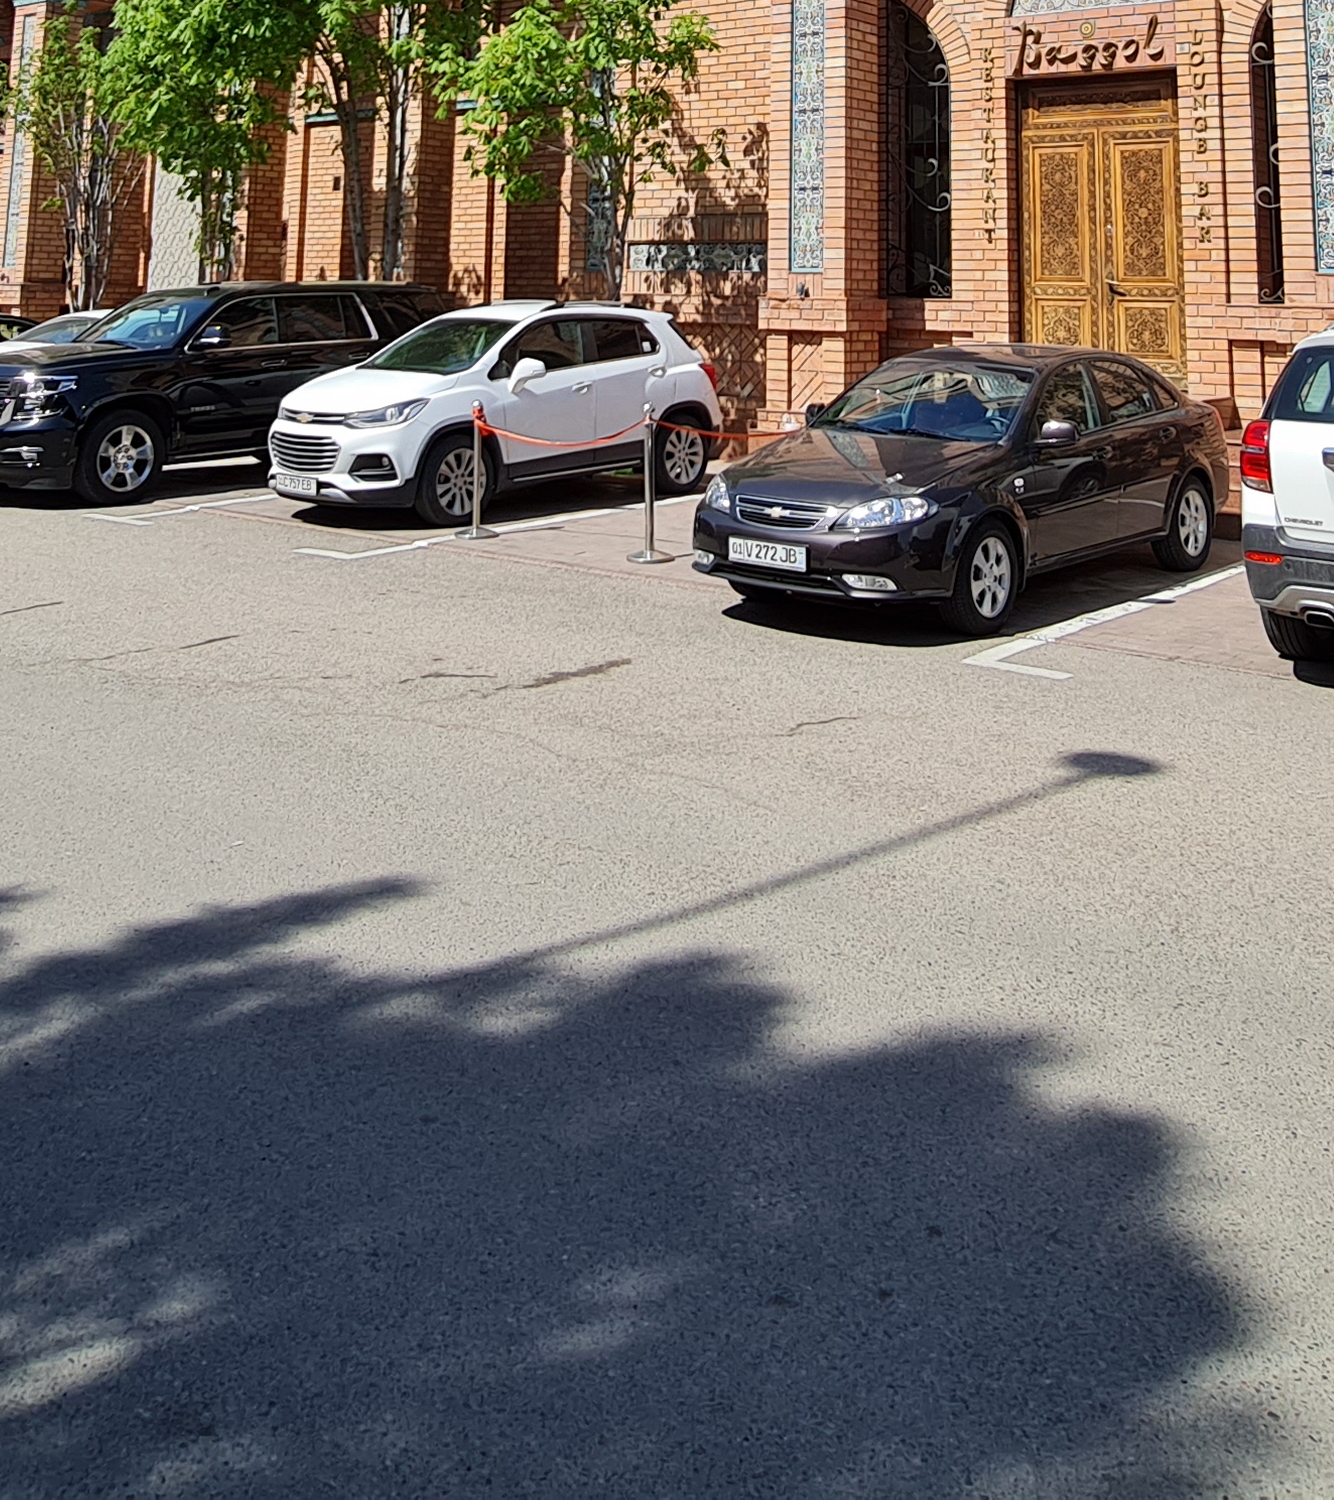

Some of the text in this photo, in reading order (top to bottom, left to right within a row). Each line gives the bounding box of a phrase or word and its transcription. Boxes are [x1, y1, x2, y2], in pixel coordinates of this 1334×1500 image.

[981, 48, 996, 244] RESTAURANT
[1190, 29, 1212, 243] LOUNGE BAR
[732, 542, 742, 555] 01
[755, 544, 778, 562] 272
[779, 547, 797, 564] JB
